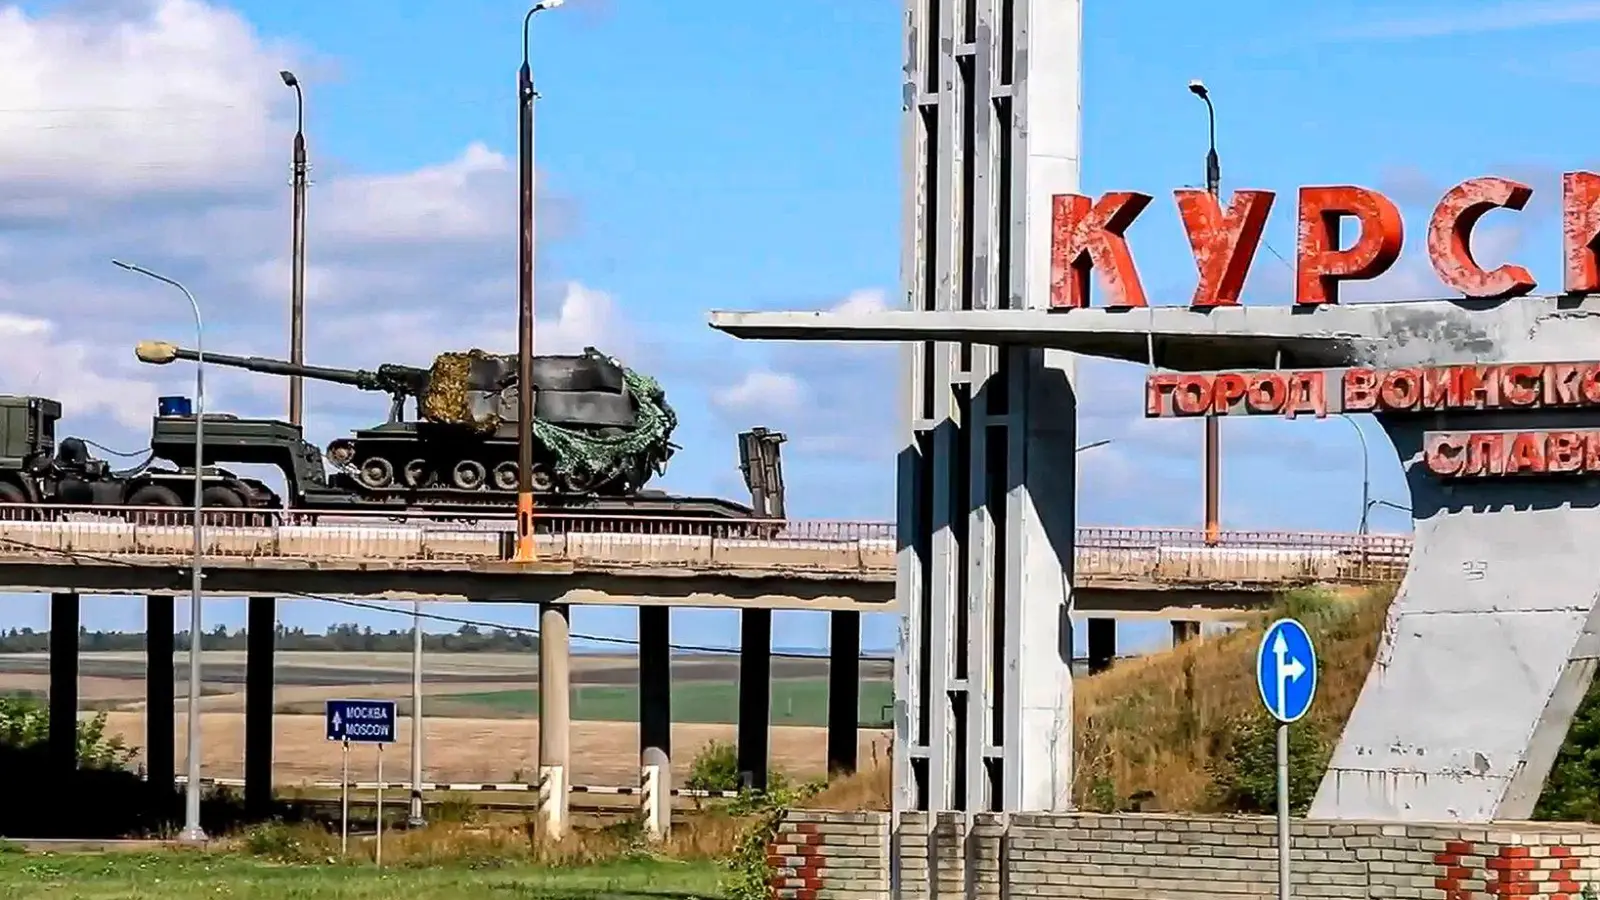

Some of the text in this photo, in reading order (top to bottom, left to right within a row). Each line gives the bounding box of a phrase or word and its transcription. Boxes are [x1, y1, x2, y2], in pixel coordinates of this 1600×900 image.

[1147, 373, 1326, 419] ГОРОД
[1426, 433, 1600, 475] СЛАВ
[346, 707, 388, 719] МОСКВА
[346, 723, 389, 736] MOSCOW
